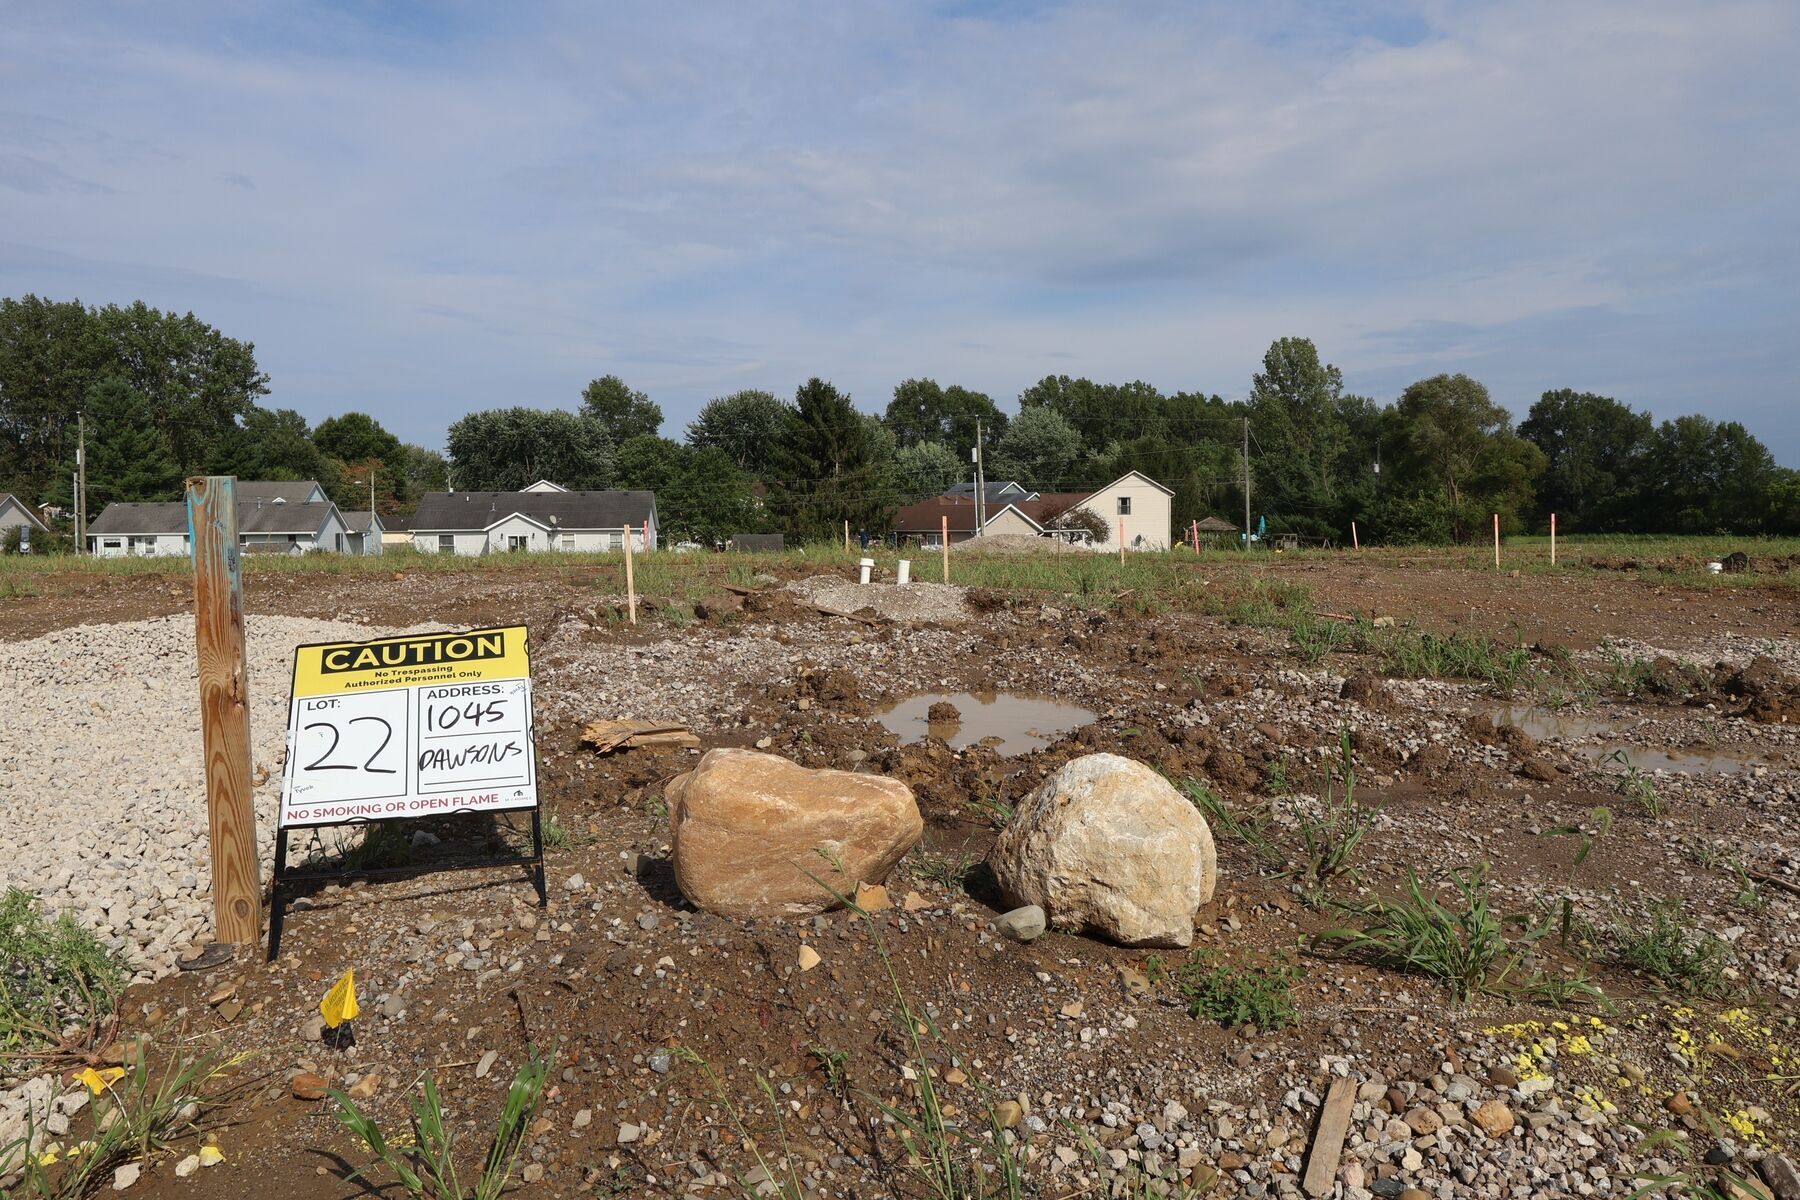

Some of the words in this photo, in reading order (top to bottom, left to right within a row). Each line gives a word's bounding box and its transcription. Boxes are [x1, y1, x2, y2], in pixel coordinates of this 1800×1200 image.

[325, 635, 502, 670] CAUTION
[344, 677, 402, 689] Authorized
[405, 673, 456, 684] Personnel
[459, 670, 482, 679] Only
[391, 665, 453, 677] Trespassing
[307, 699, 341, 711] LOT:
[427, 685, 505, 700] ADDRESS:
[427, 700, 508, 732] 1045
[303, 716, 397, 774] 22
[419, 741, 522, 771] DAWSONS
[287, 810, 309, 820] NO
[313, 804, 382, 818] SMOKING
[385, 802, 406, 812] OR
[409, 798, 448, 810] OPEN
[452, 794, 499, 806] FLAME
